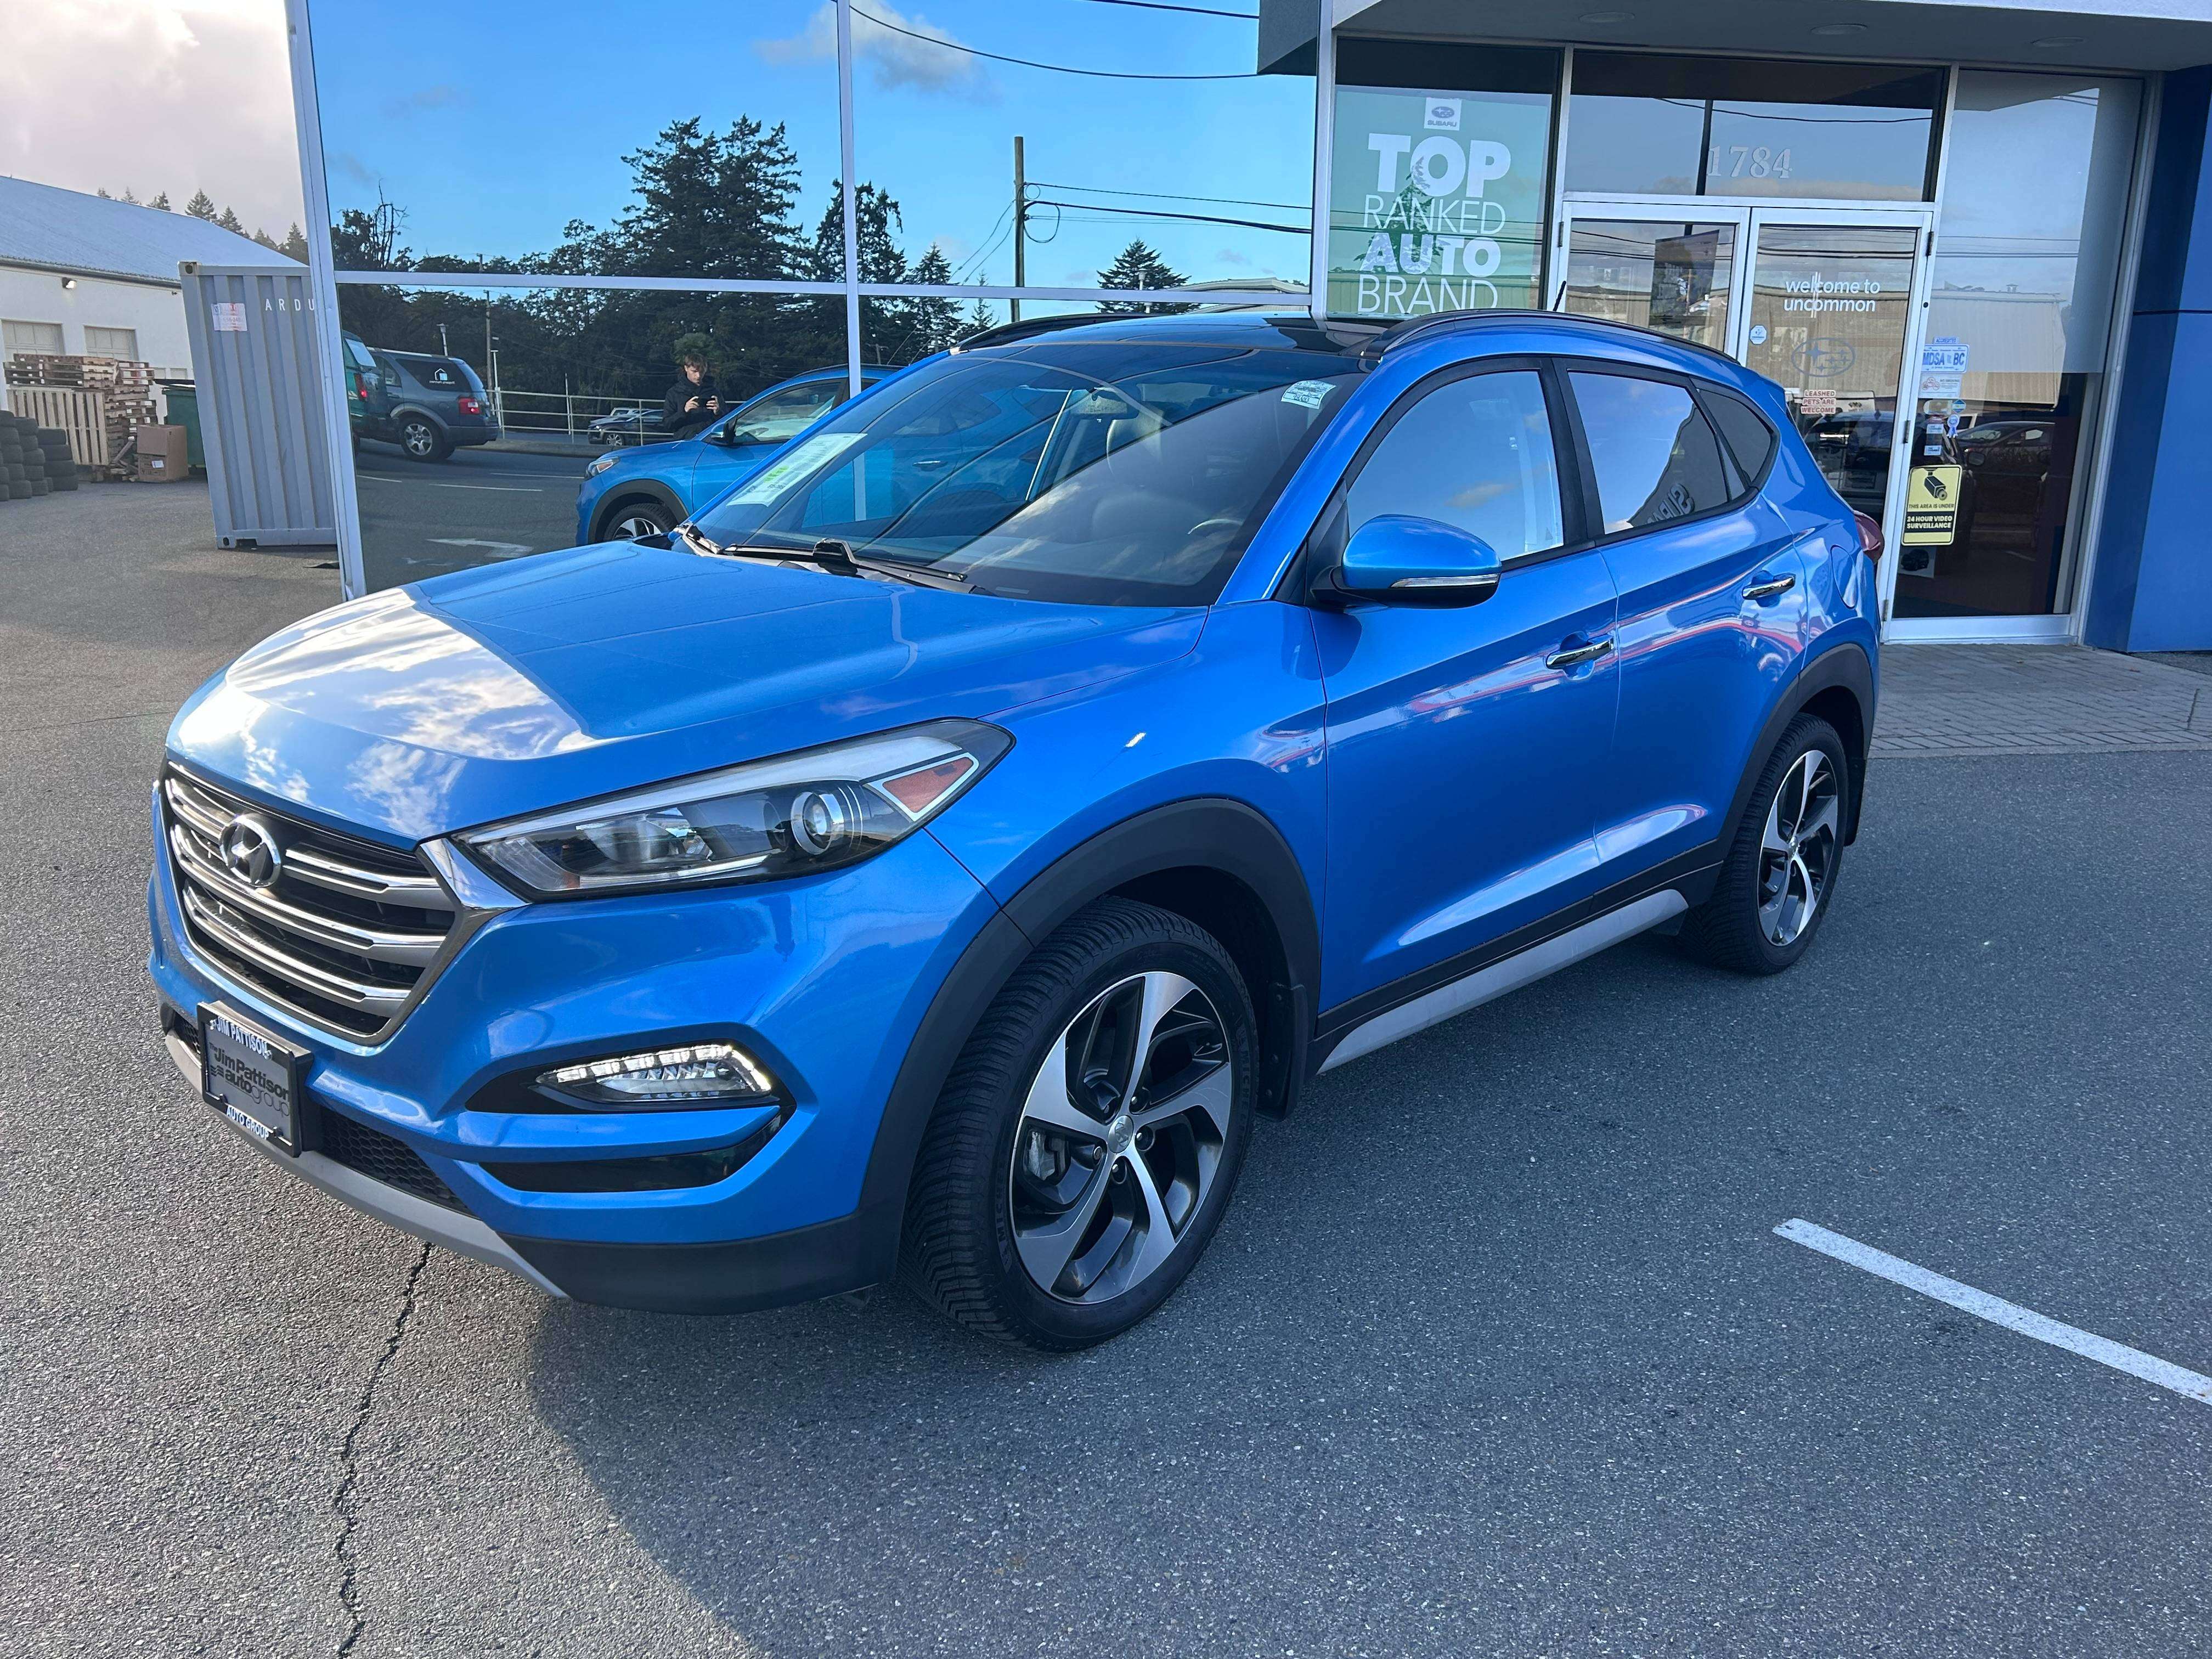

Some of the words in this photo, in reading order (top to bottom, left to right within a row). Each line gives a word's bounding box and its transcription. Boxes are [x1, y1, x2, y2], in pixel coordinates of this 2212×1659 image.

[1368, 133, 1511, 198] TOP
[1706, 145, 1793, 179] 1784
[1363, 194, 1506, 234] RANKED
[1359, 233, 1501, 277] AUTO
[1358, 274, 1498, 313] BRAND
[1786, 275, 1860, 294] welcome
[1864, 279, 1881, 294] to
[1784, 298, 1876, 312] uncommon
[1953, 352, 1965, 365] BC
[217, 1016, 230, 1036] JIM
[230, 1023, 268, 1057] PATTISON
[226, 1105, 245, 1125] AUTO
[245, 1117, 269, 1140] GROUP
